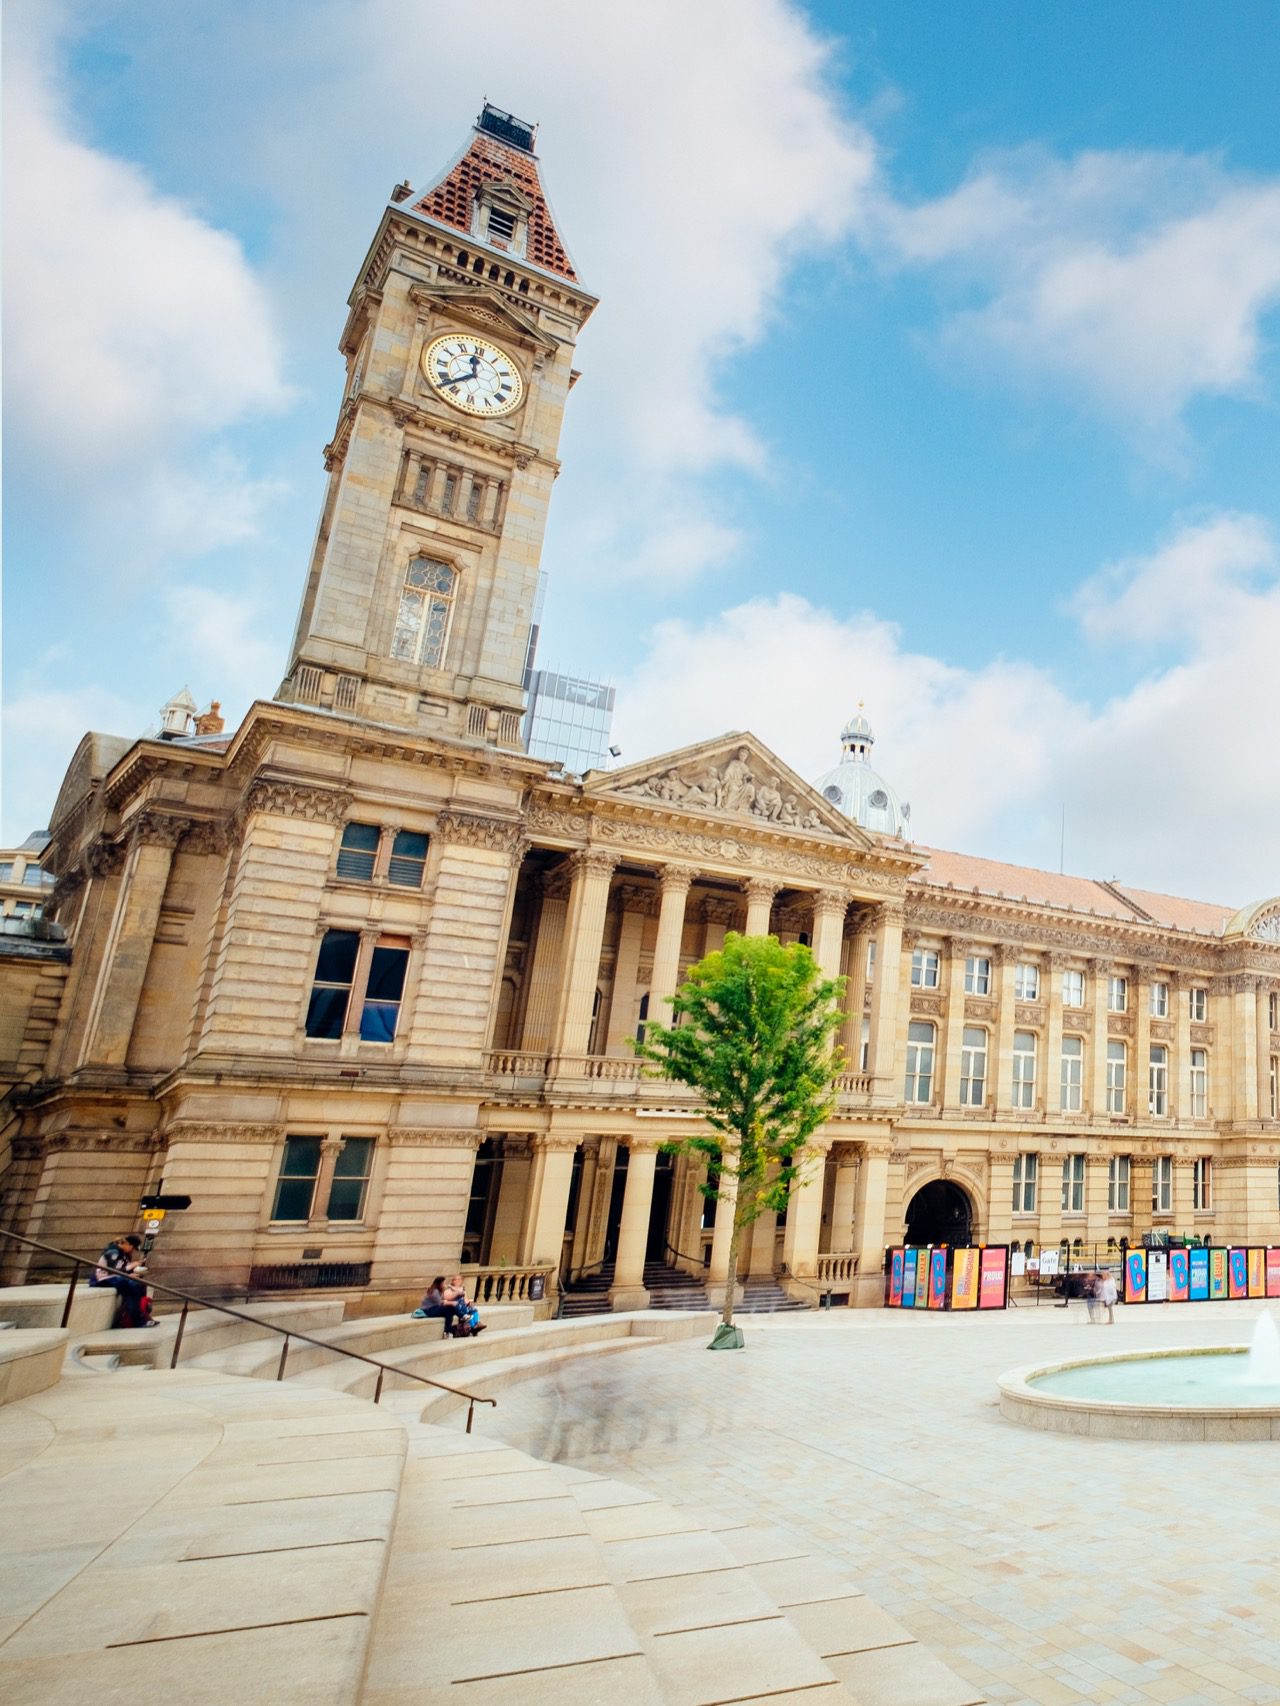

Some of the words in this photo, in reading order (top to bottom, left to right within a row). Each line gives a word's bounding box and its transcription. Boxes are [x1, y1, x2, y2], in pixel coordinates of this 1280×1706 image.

[474, 345, 485, 357] XII
[933, 1253, 946, 1296] B
[1042, 1256, 1057, 1264] Gate
[1128, 1253, 1146, 1291] B
[1172, 1253, 1188, 1290] B
[1231, 1253, 1246, 1287] B
